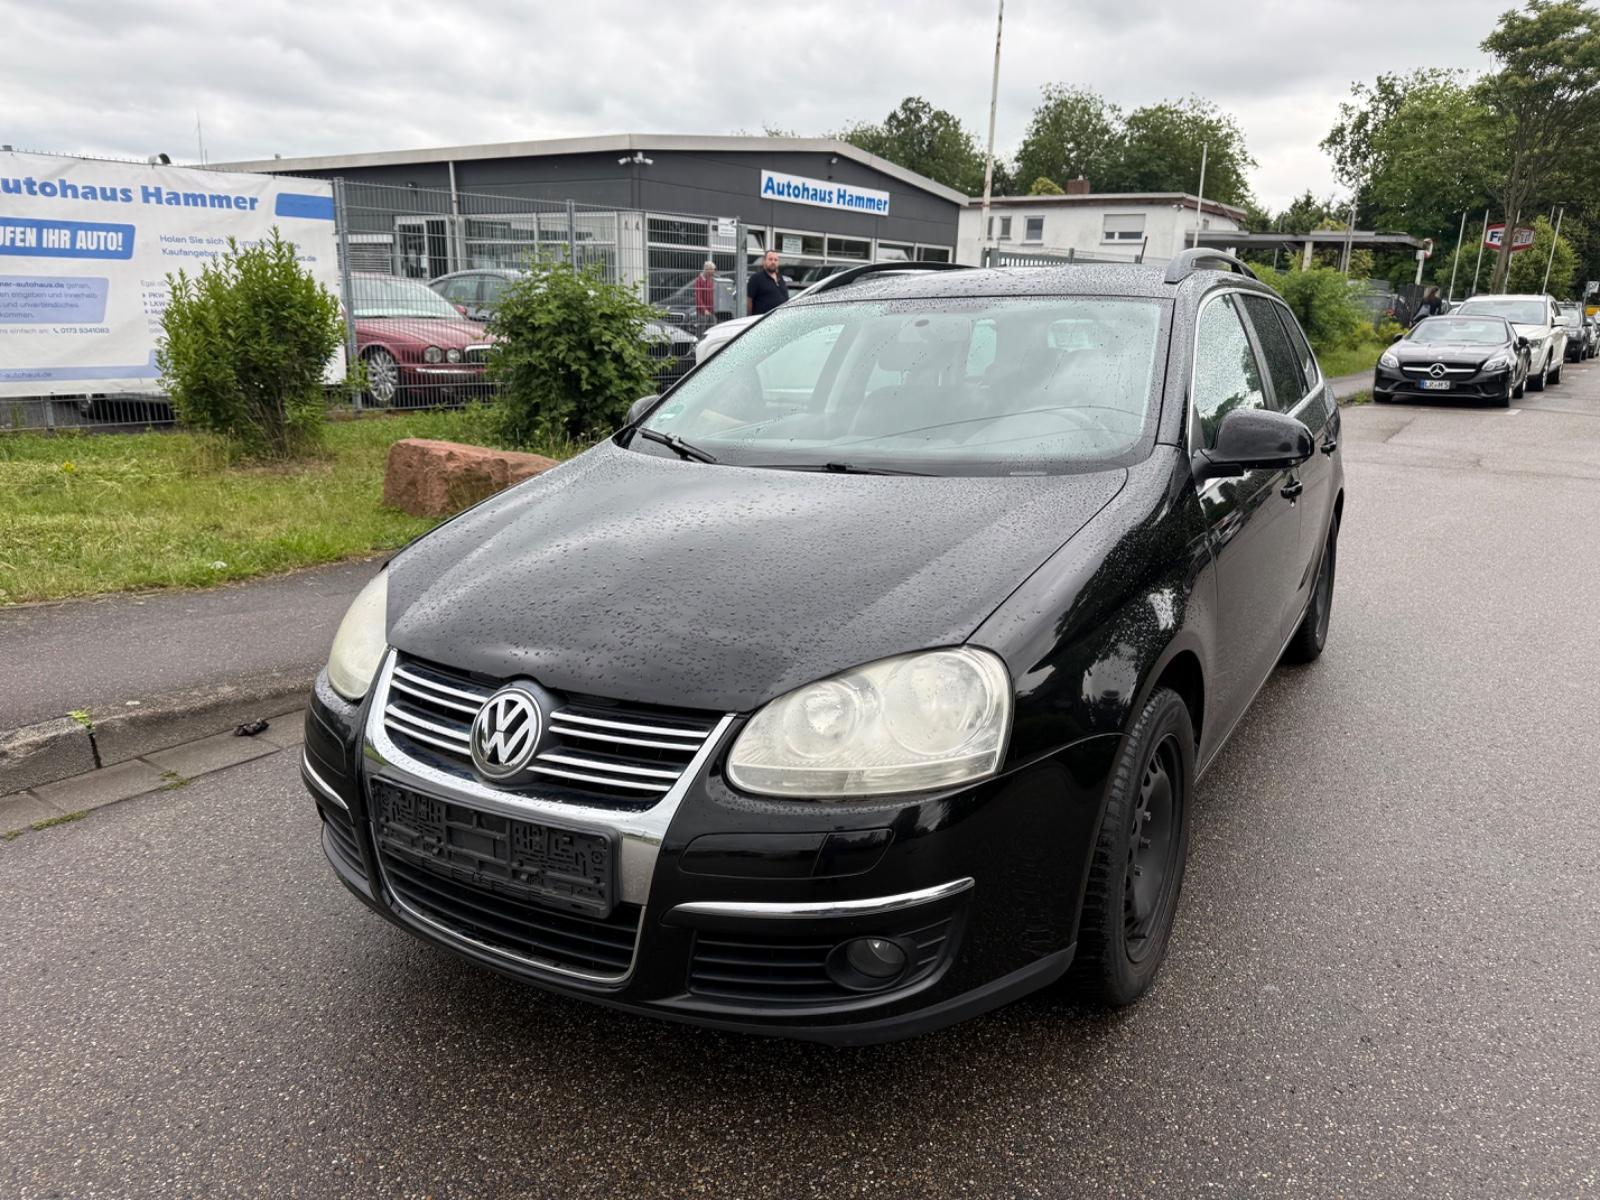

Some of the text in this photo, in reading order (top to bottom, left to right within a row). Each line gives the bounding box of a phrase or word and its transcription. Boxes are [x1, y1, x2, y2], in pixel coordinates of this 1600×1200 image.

[0, 176, 259, 211] utohaus Hammer
[763, 176, 888, 212] Autohaus Hammer
[42, 228, 71, 250] IHR
[75, 230, 123, 252] AUTO!
[160, 234, 187, 244] Holen
[188, 235, 204, 245] Sie
[206, 237, 224, 246] sich
